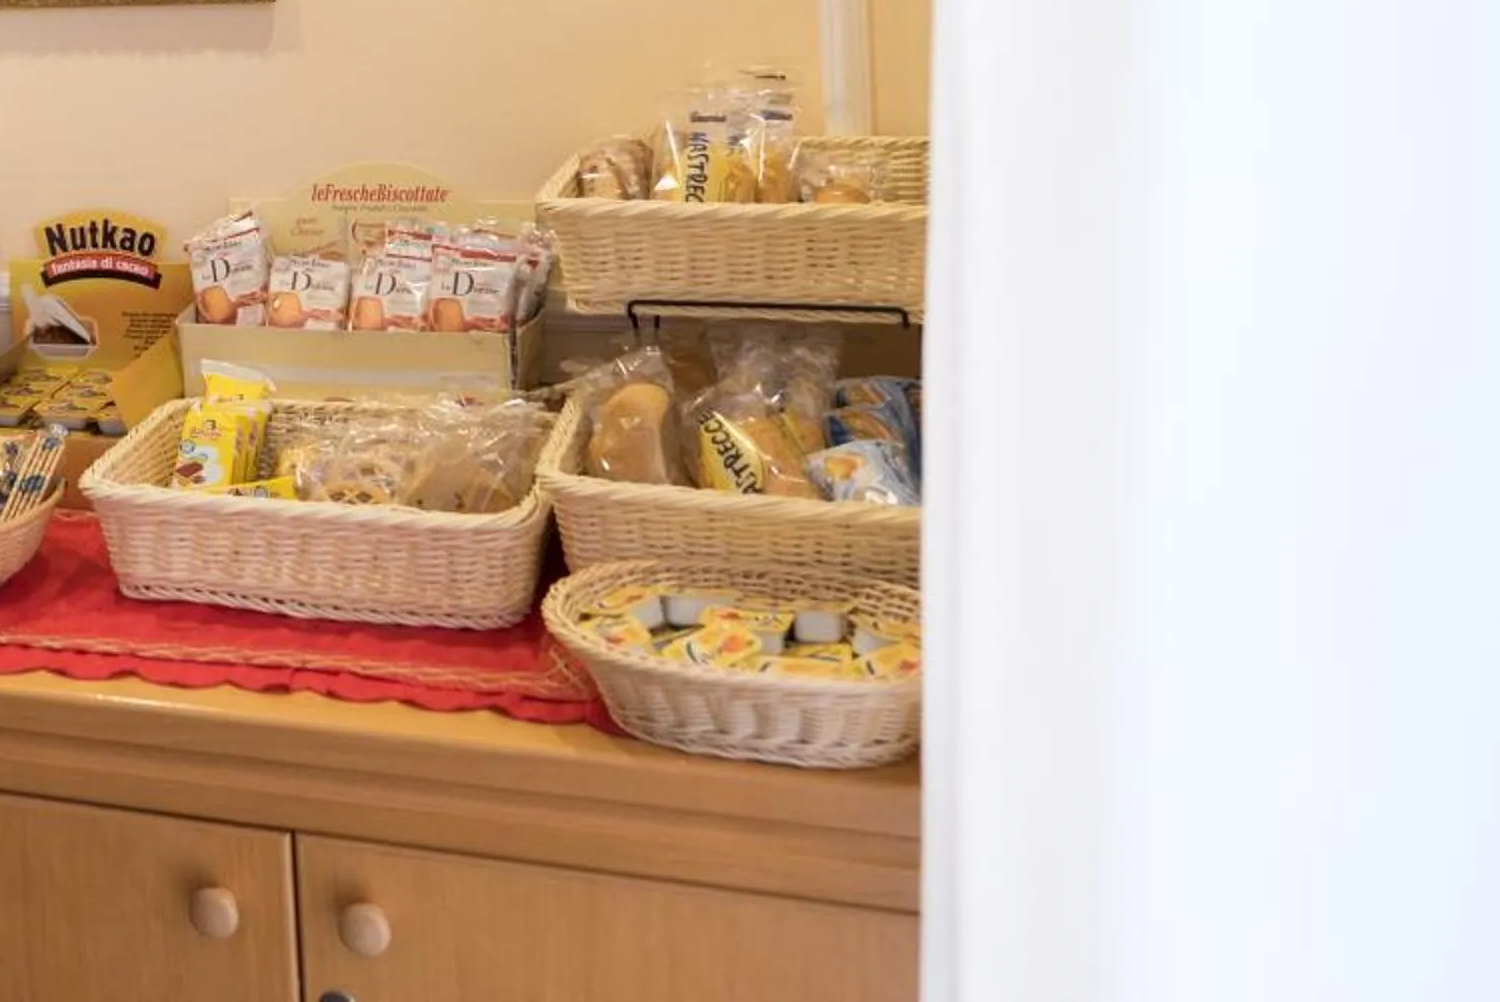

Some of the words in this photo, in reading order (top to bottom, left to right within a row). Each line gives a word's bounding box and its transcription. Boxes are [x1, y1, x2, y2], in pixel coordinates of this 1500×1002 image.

[685, 132, 710, 203] NASTREC
[44, 218, 156, 256] Nutkao
[101, 256, 113, 269] di
[115, 260, 150, 276] cacao
[698, 407, 764, 494] ASTRECCE
